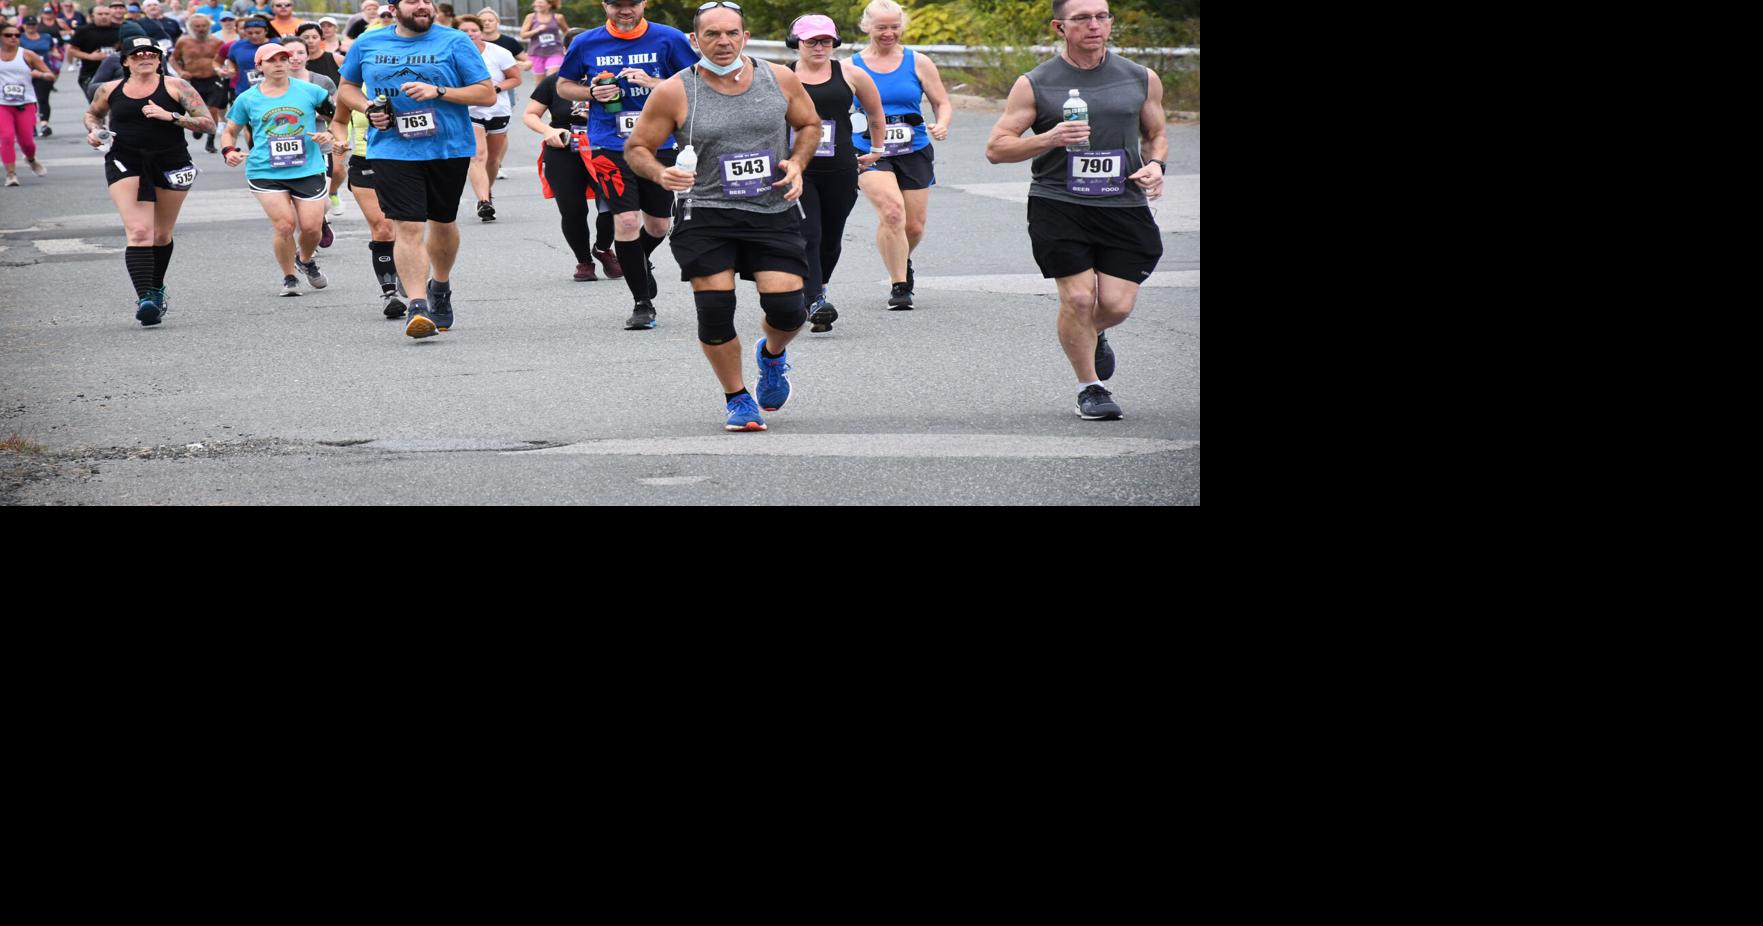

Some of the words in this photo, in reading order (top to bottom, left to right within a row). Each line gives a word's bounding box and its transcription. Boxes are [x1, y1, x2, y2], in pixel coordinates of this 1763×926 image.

[375, 55, 400, 65] BEE
[596, 55, 623, 67] BEE
[374, 88, 400, 97] BAD
[402, 115, 428, 129] 763
[275, 141, 299, 152] 805
[731, 159, 765, 176] 543
[1080, 158, 1113, 173] 790
[175, 171, 193, 184] 515
